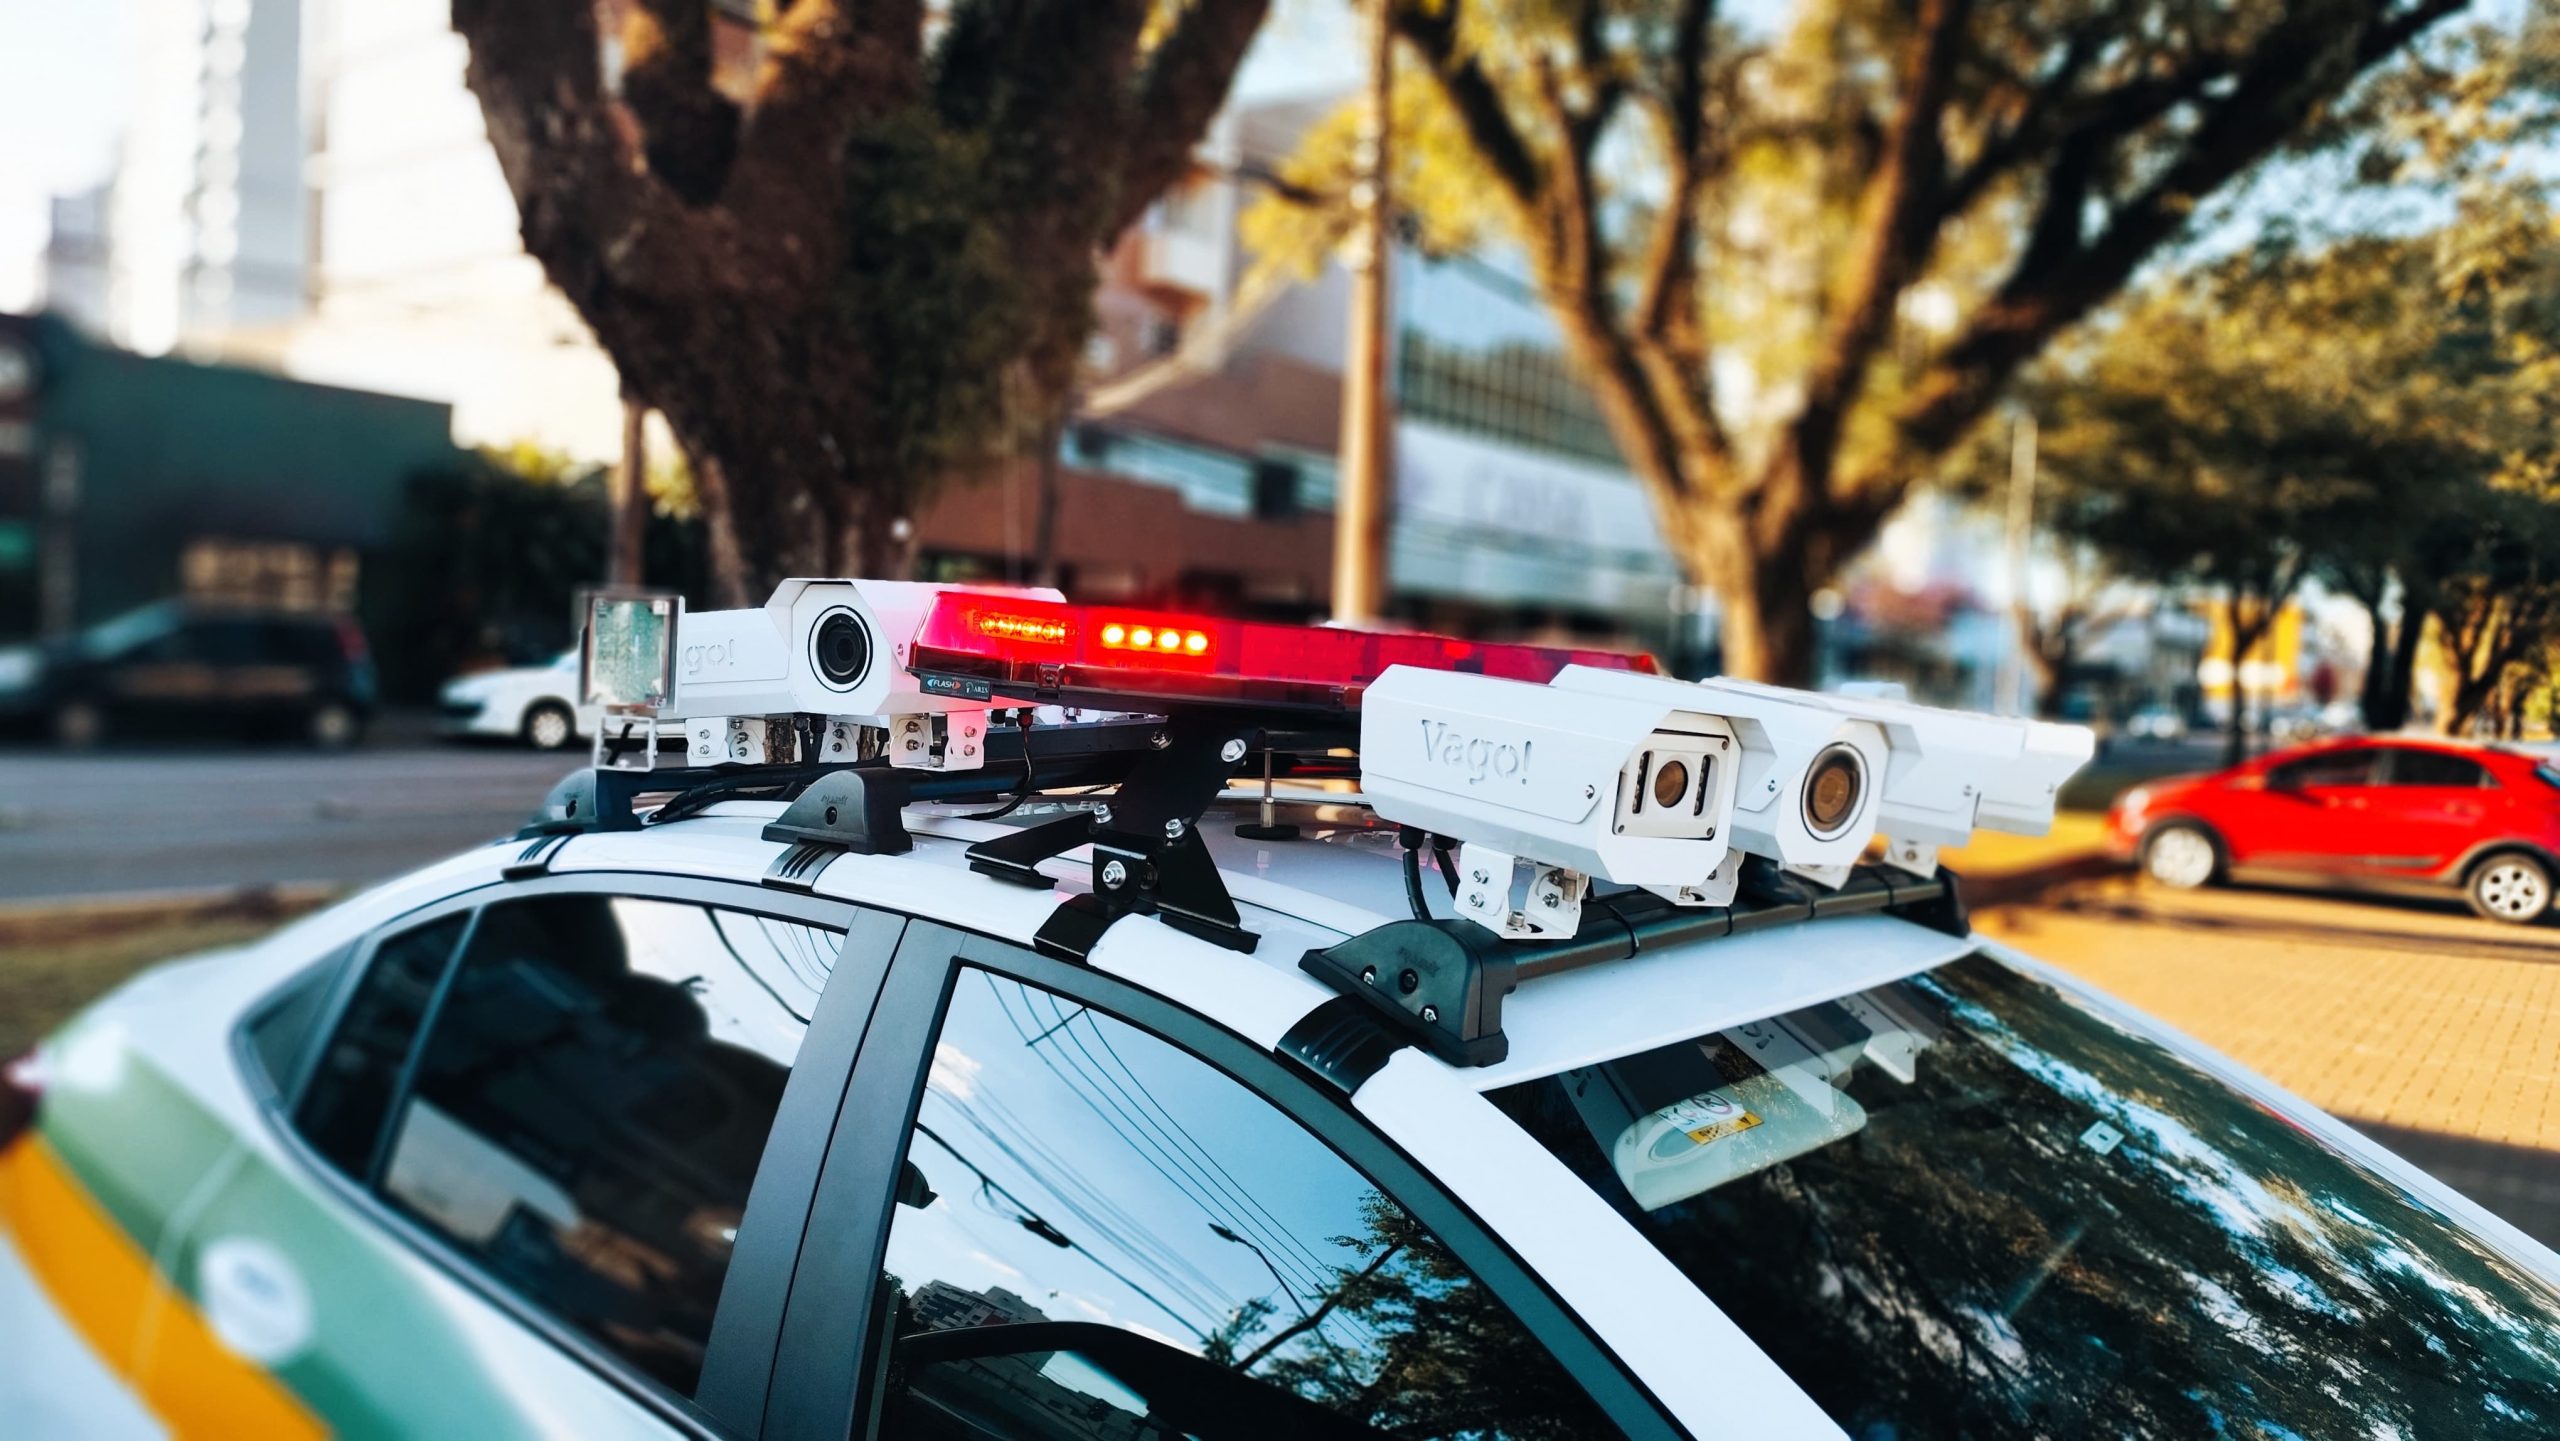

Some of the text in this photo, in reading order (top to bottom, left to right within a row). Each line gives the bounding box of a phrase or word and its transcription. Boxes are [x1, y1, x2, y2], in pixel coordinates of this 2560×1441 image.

[685, 638, 735, 676] go!
[932, 679, 956, 689] FLASH
[1421, 719, 1533, 785] Vago!
